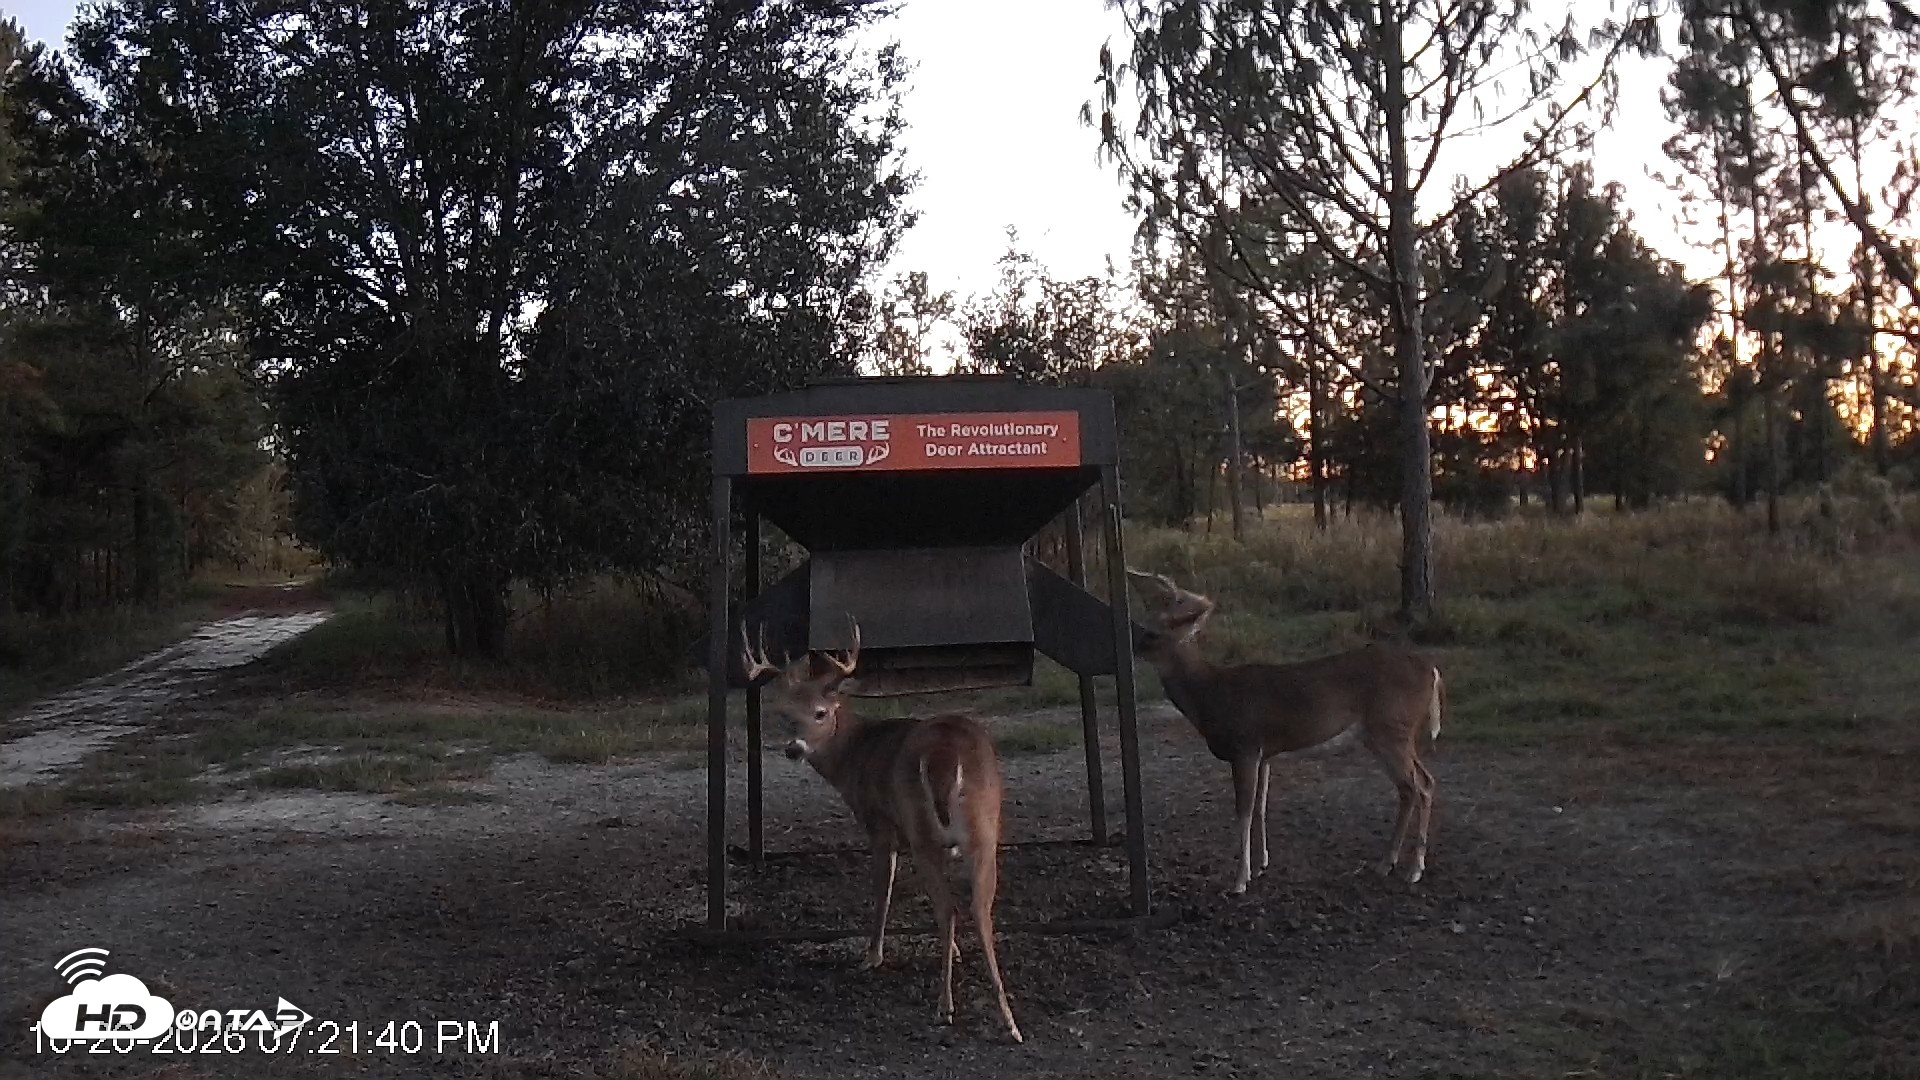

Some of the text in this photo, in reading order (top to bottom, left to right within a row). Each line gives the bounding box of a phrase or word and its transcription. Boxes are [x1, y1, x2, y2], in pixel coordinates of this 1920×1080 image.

[773, 419, 890, 443] C'MERE
[917, 422, 1059, 439] The Revolutionary
[805, 450, 859, 463] DEER
[925, 440, 1048, 457] Deer Attractant
